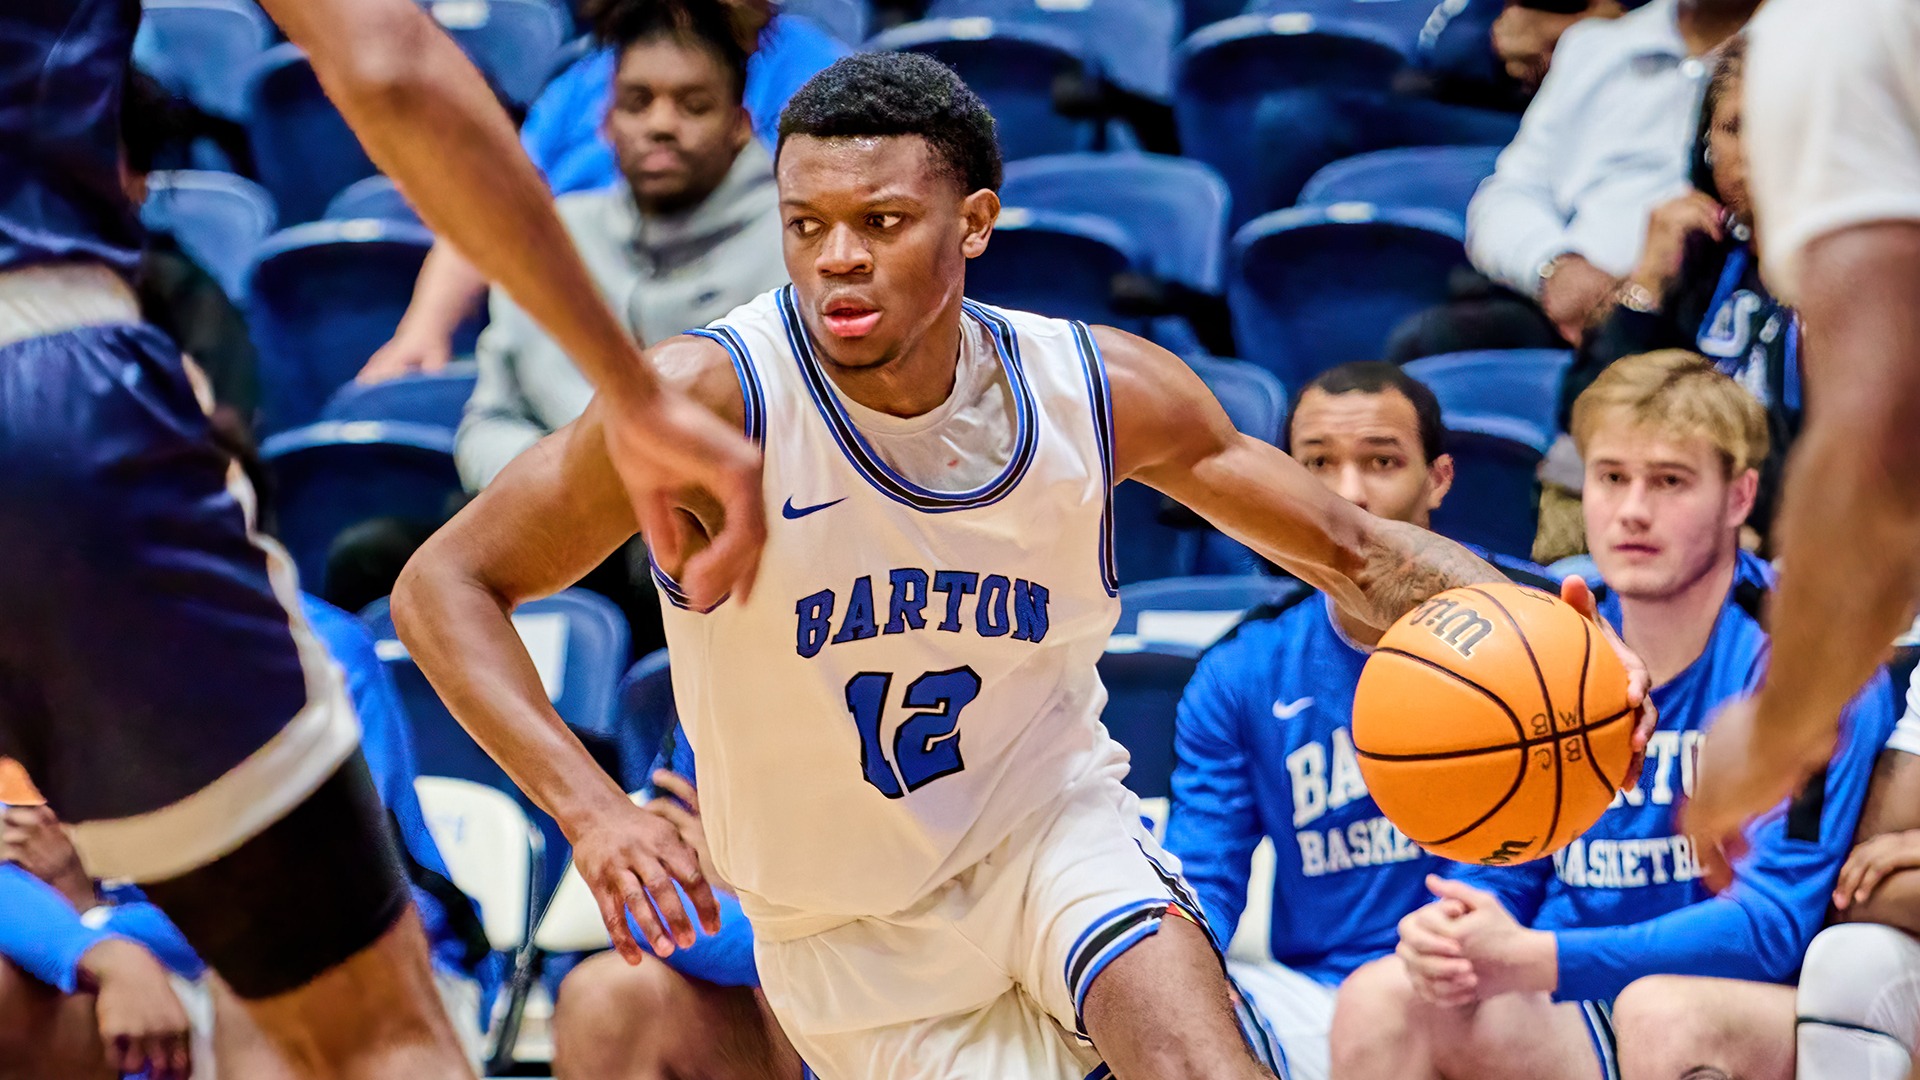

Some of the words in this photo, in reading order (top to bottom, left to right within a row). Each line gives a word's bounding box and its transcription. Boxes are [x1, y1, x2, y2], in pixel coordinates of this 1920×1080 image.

[795, 567, 1050, 659] BARTON
[1409, 597, 1493, 657] Wil
[845, 664, 982, 799] 12
[1286, 725, 1369, 829] BA
[1296, 816, 1422, 877] BASKE
